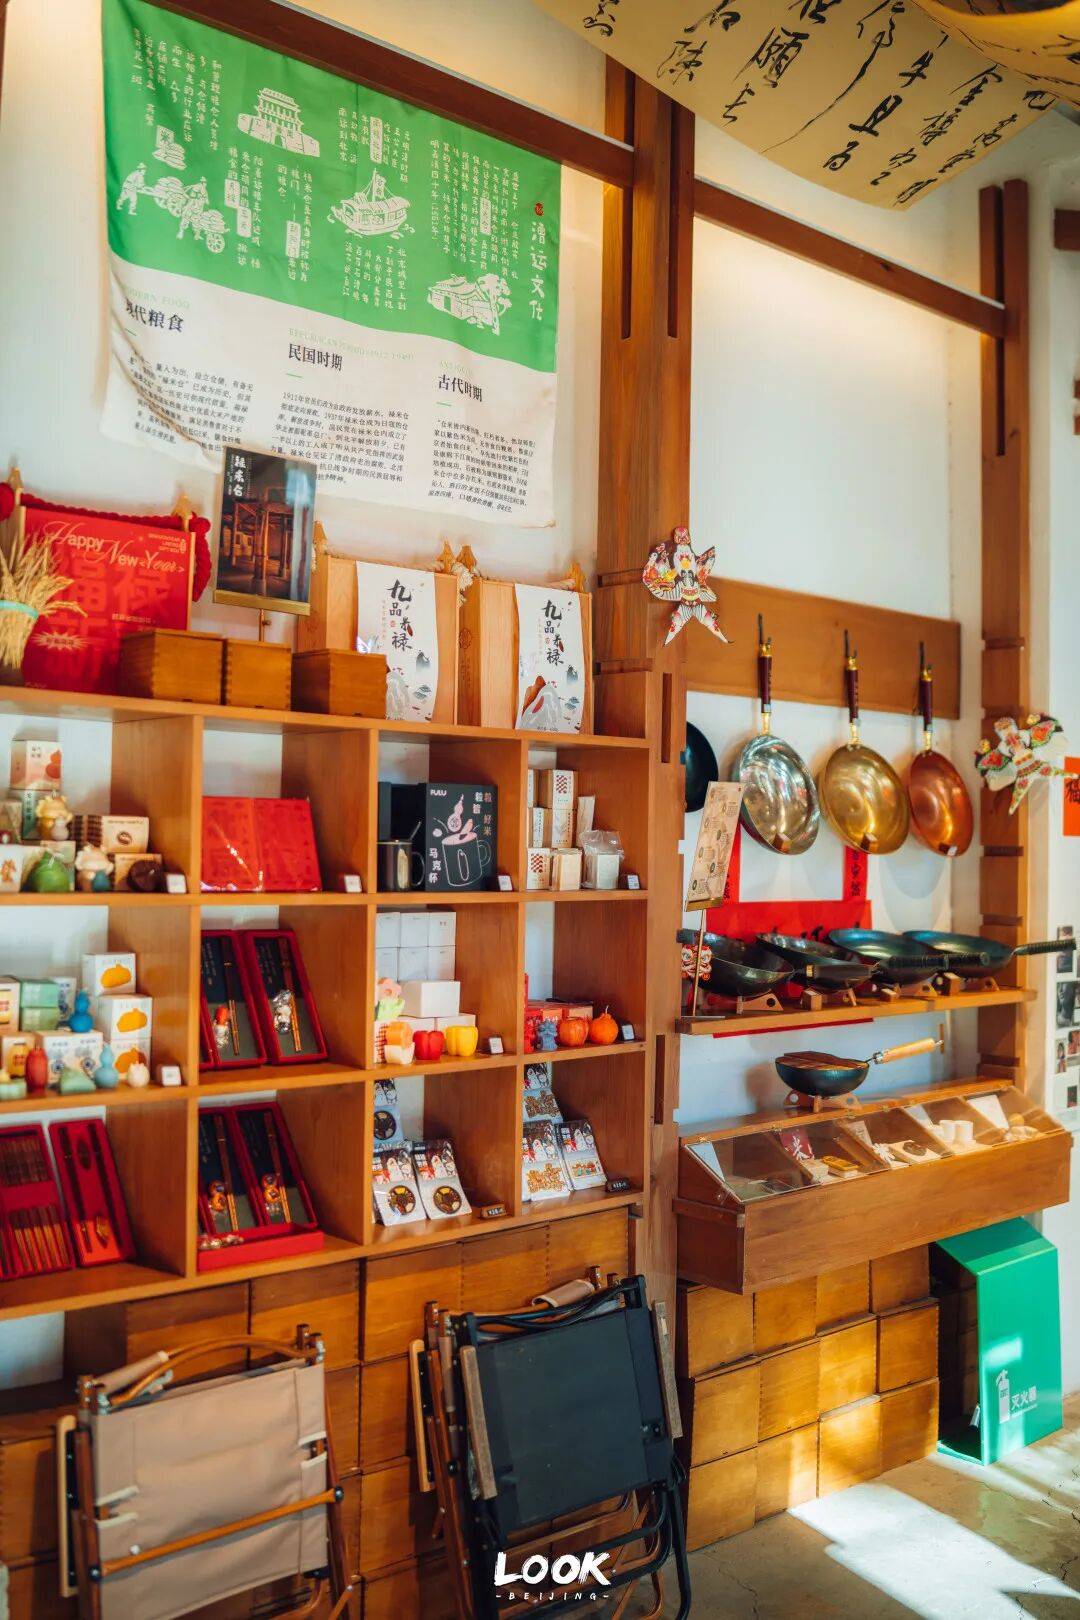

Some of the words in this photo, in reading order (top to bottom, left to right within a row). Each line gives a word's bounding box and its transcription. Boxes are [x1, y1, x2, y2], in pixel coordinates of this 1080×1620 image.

[288, 343, 344, 372] 民国时期
[436, 374, 483, 403] 古代时期
[43, 519, 105, 553] Happy
[84, 538, 139, 566] New
